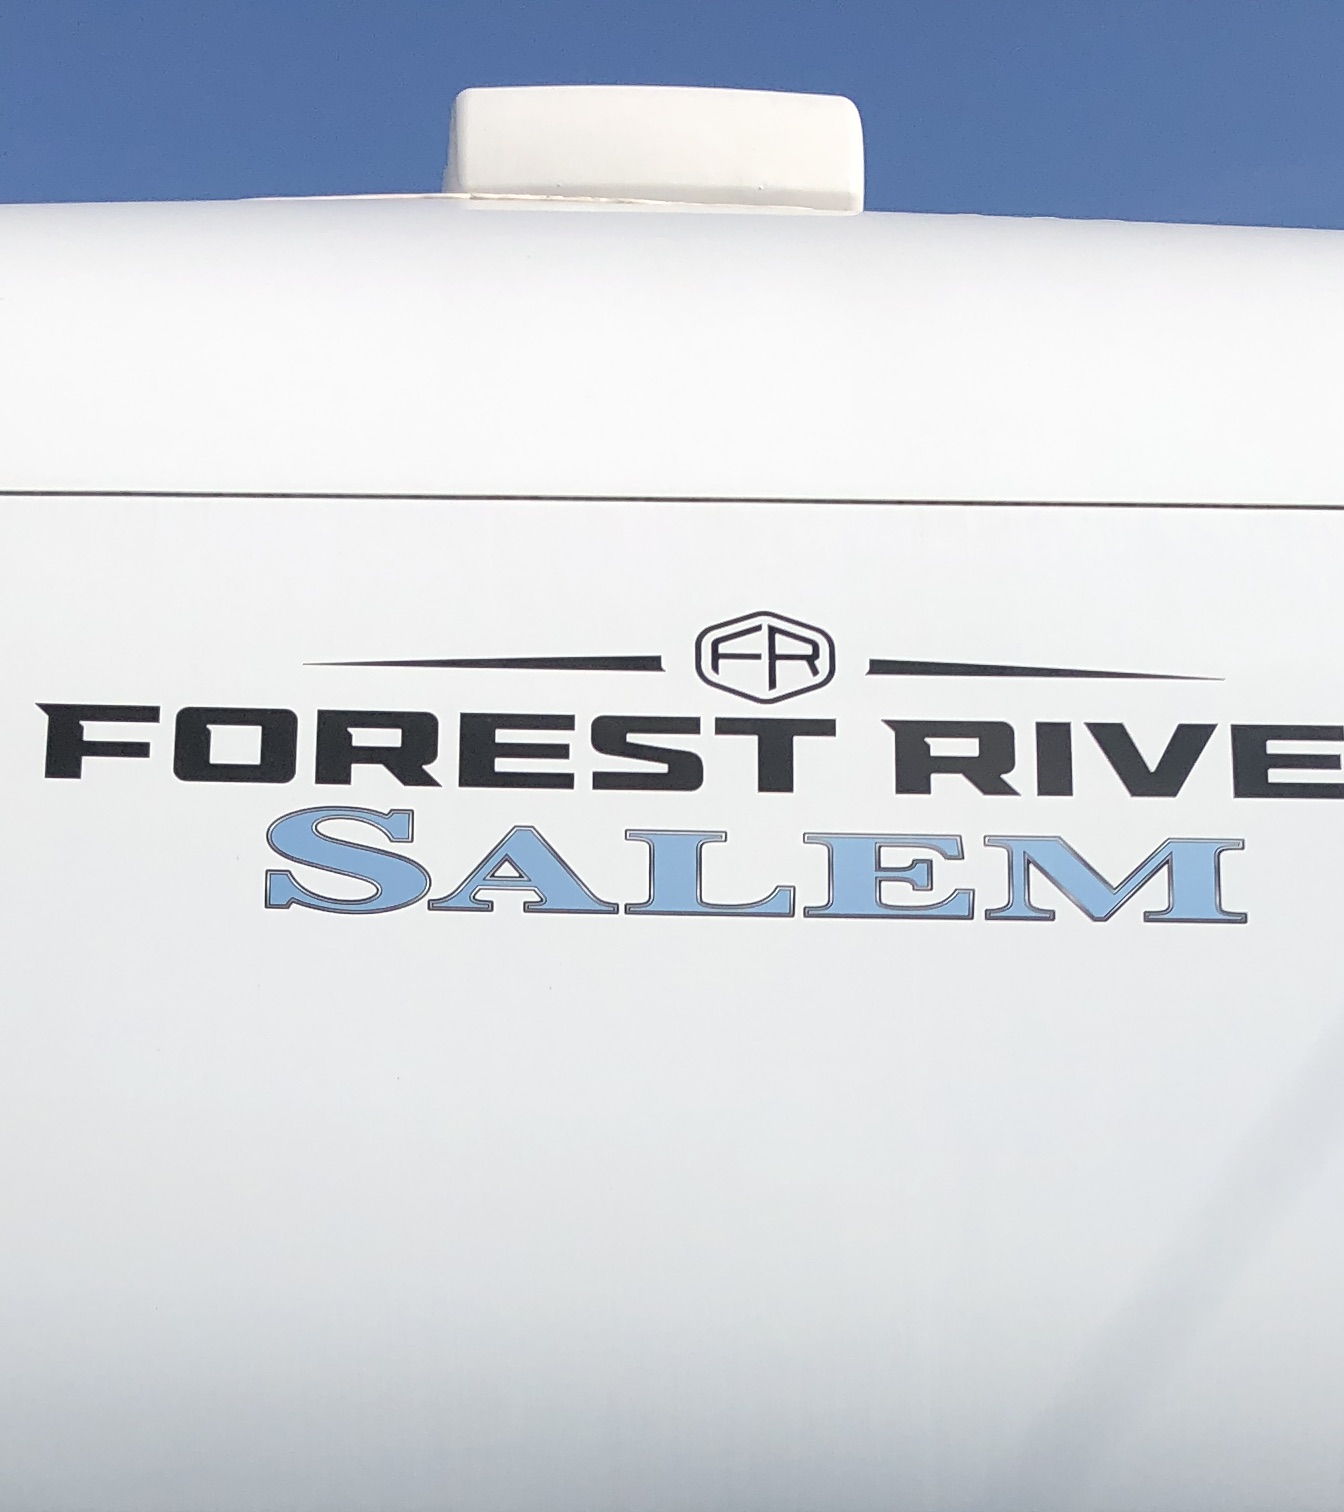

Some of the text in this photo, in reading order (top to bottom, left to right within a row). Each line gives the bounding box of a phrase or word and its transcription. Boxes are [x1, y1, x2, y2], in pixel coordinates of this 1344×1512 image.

[711, 623, 820, 691] FR
[35, 703, 837, 793] FOREST
[264, 804, 1250, 925] SALEM
